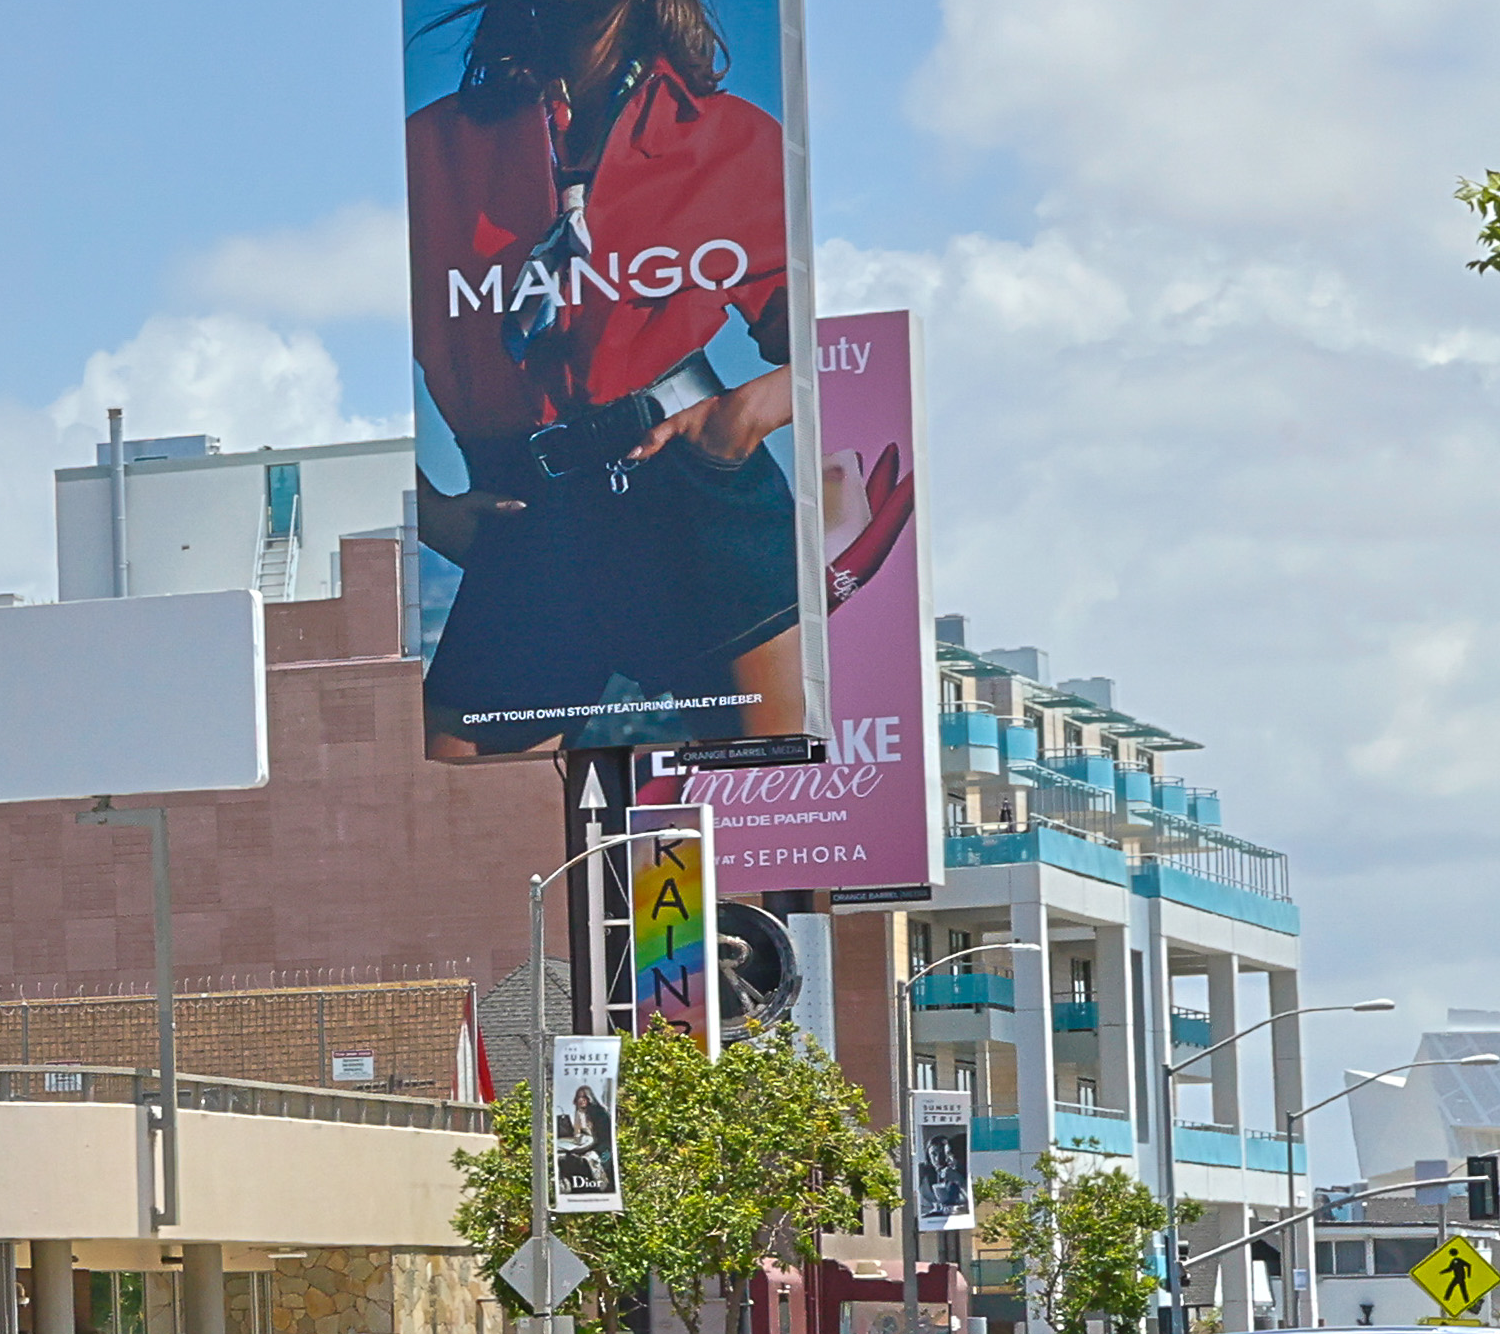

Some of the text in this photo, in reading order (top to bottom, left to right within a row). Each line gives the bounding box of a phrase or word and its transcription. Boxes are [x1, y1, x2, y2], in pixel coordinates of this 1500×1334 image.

[449, 239, 748, 317] MANGO
[463, 694, 762, 724] CRAFT YOUR OWN STORY FEATURING HAILEY BIEBER
[681, 764, 883, 805] intense
[747, 815, 770, 826] DE
[774, 811, 847, 825] PARFUM
[743, 844, 867, 867] SEPHORA
[564, 1053, 608, 1062] SUNSET
[564, 1068, 607, 1076] STRIP
[572, 1175, 604, 1188] Dior
